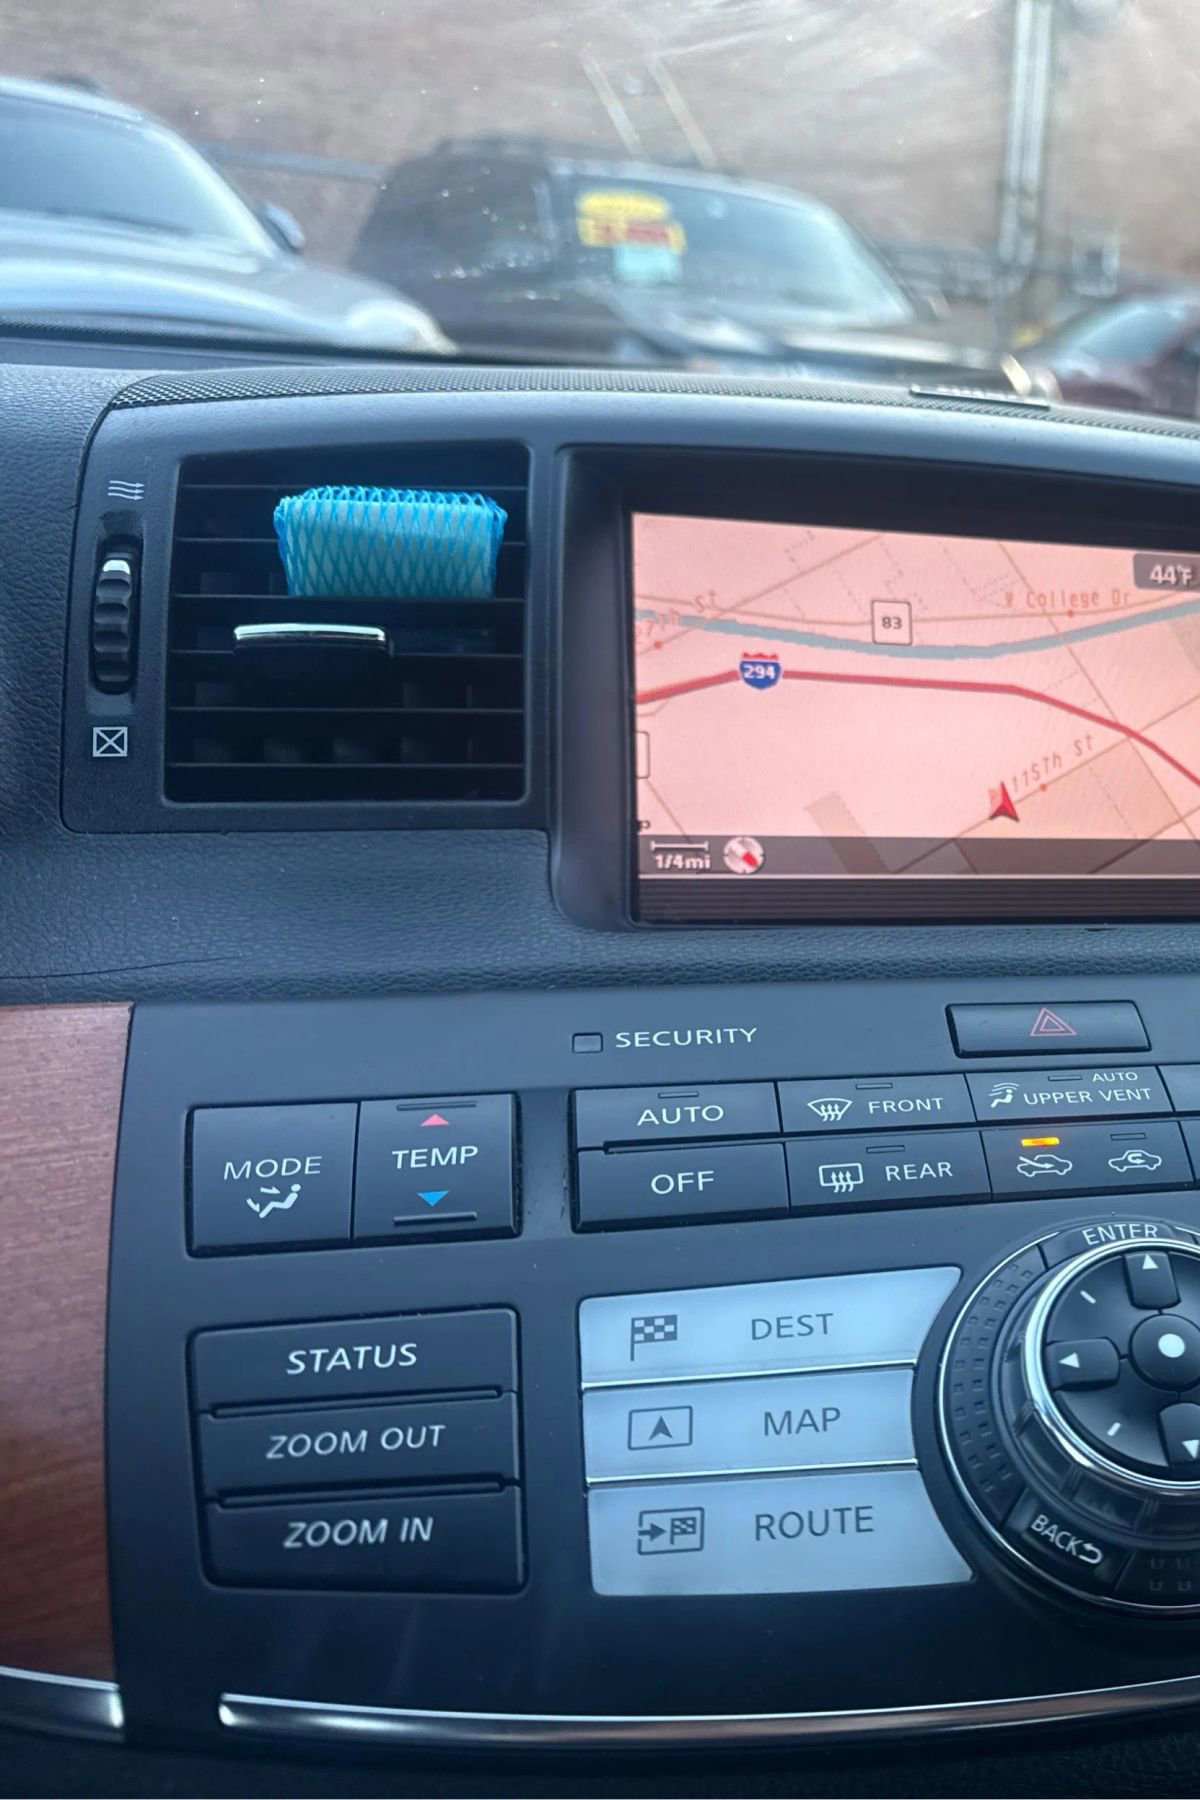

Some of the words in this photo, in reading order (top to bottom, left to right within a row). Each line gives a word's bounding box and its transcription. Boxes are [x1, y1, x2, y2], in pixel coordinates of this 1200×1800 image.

[1026, 589, 1100, 608] College
[1111, 588, 1131, 607] Dr
[881, 616, 903, 630] 83
[742, 663, 776, 680] 294
[1073, 733, 1094, 757] St
[655, 853, 711, 870] 1/4mi
[614, 1026, 759, 1049] SECURITY
[1091, 1070, 1139, 1083] AUTO
[867, 1097, 945, 1115] FRONT
[1023, 1089, 1093, 1106] UPPER
[1099, 1087, 1152, 1102] VENT
[637, 1104, 725, 1127] AUTO
[222, 1155, 323, 1182] MODE
[392, 1145, 479, 1170] TEMP
[650, 1170, 715, 1194] OFF
[884, 1160, 953, 1181] REAR
[1081, 1223, 1158, 1246] ENTER
[751, 1312, 836, 1340] DEST
[286, 1342, 418, 1375] STATUS
[763, 1406, 842, 1437] MAP
[266, 1428, 368, 1460] ZOOM
[380, 1424, 446, 1452] OUT
[283, 1518, 388, 1549] ZOOM
[400, 1516, 434, 1543] IN
[754, 1505, 875, 1541] ROUTE
[1030, 1513, 1082, 1559] BACK
